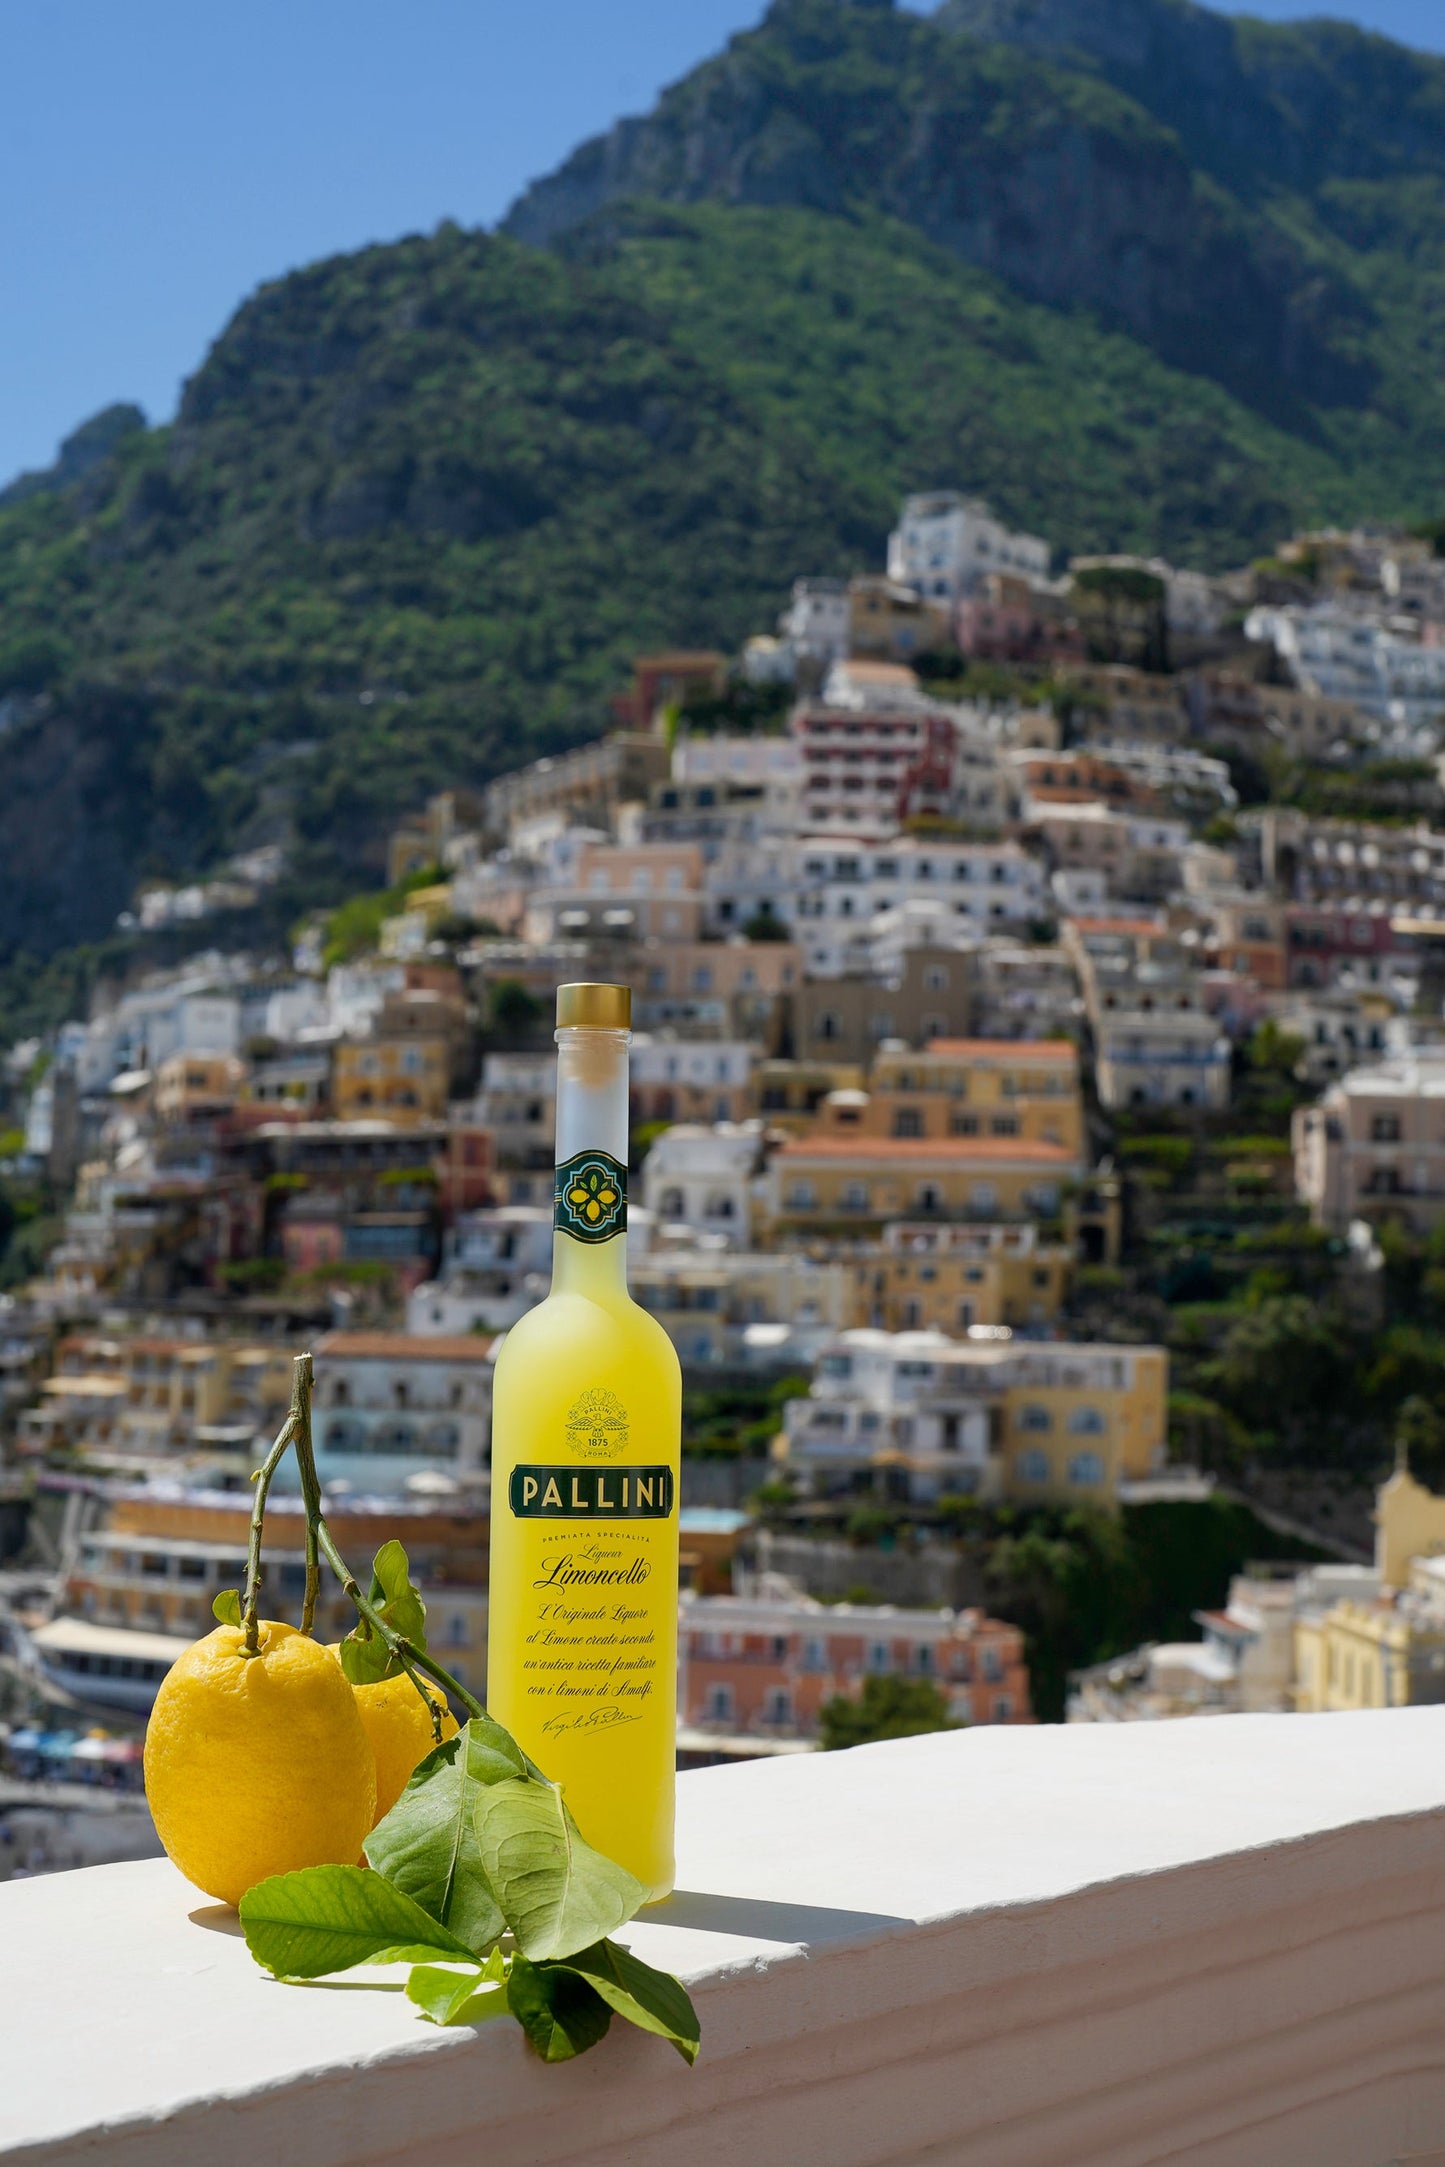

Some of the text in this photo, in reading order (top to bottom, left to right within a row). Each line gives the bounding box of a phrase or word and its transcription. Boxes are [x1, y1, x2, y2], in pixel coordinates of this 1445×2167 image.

[584, 1406, 613, 1416] PALLINI
[588, 1438, 609, 1447] 1875
[523, 1476, 664, 1508] PALLINI
[542, 1532, 591, 1543] PREMIATA
[577, 1543, 623, 1564] Liqueur
[533, 1553, 652, 1596] Limoncello
[537, 1603, 648, 1625] L'Originale Liquore
[526, 1629, 655, 1646] al Limone creato secondo
[576, 1658, 612, 1671] ricetta
[608, 1655, 657, 1676] familiare
[527, 1685, 546, 1696] con
[547, 1683, 555, 1696] i
[555, 1680, 596, 1697] limoni
[596, 1682, 611, 1697] di
